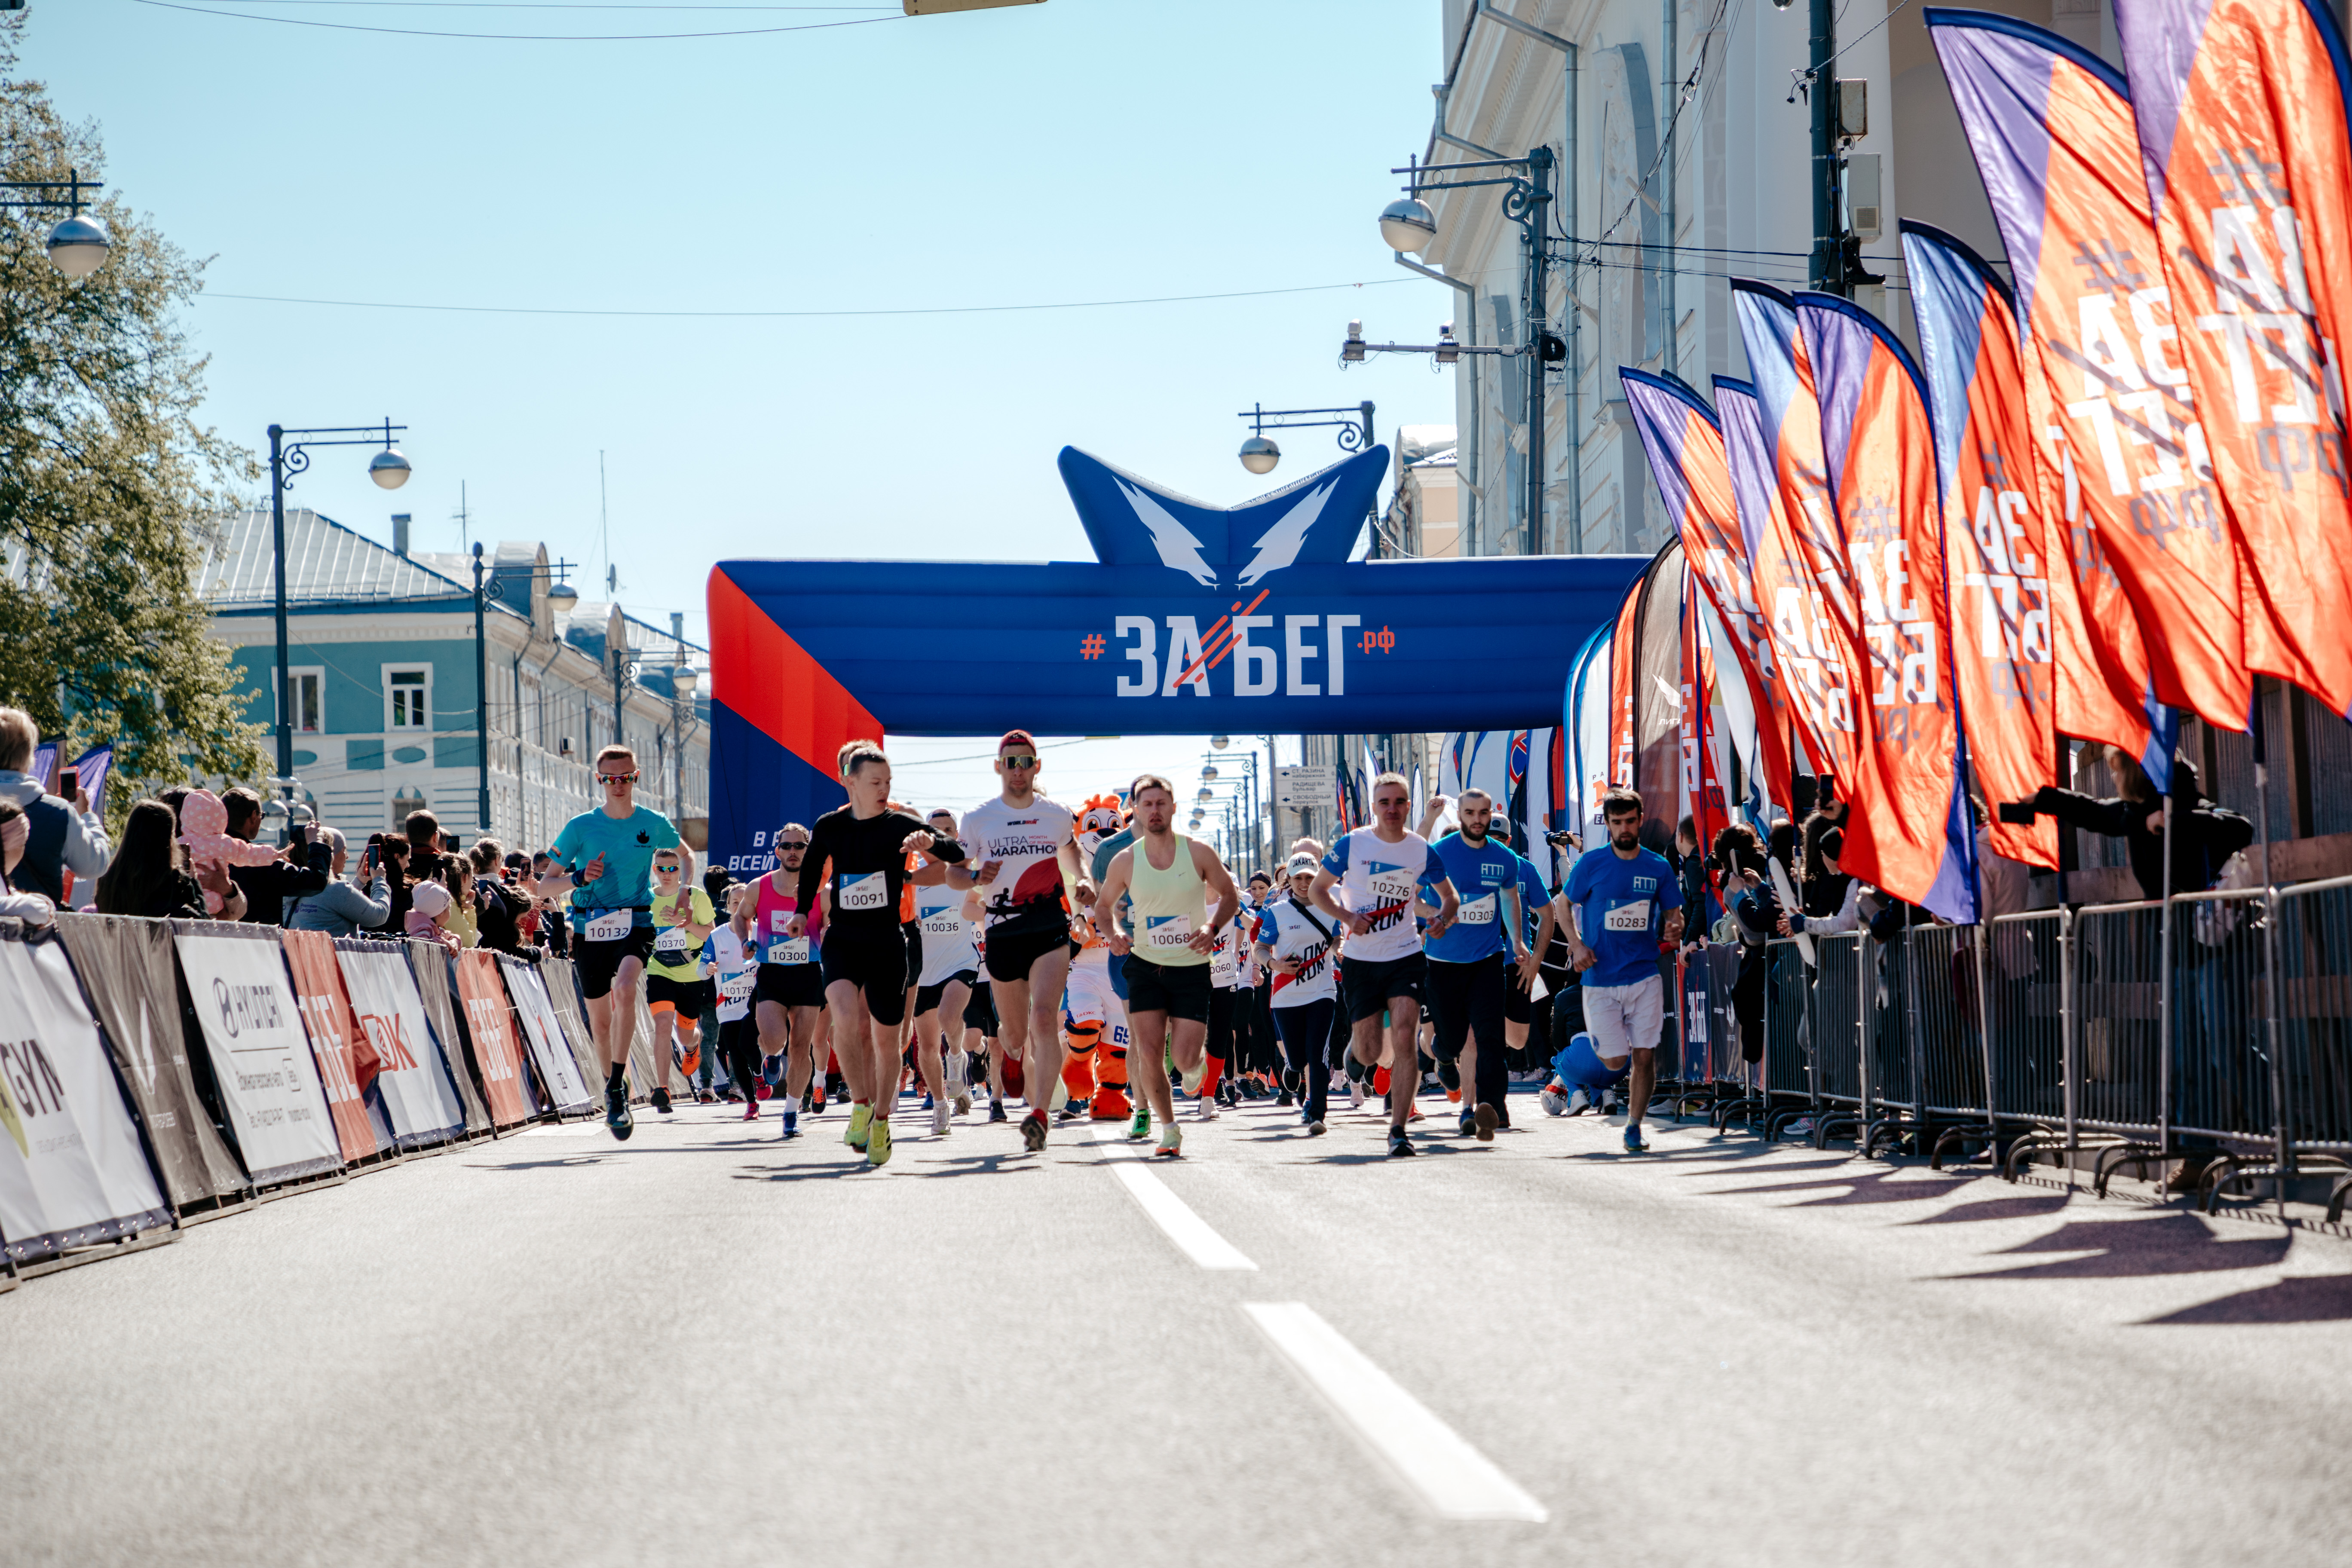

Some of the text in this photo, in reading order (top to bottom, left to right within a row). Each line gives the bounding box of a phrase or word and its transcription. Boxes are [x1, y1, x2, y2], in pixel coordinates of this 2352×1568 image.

[753, 831, 766, 847] В
[988, 836, 1029, 849] ULTRA
[728, 851, 775, 871] ВСЕЙ
[1292, 857, 1314, 868] JAKARTA
[1372, 881, 1410, 897] 10276
[844, 892, 883, 906] 10091
[1462, 910, 1494, 921] 10303
[925, 922, 959, 932] 10036
[1610, 917, 1646, 928] 10283
[590, 927, 629, 937] 10132
[657, 939, 685, 948] 10370
[1152, 933, 1190, 945] 10068
[772, 951, 807, 961] 10300
[1303, 940, 1326, 963] ON
[1210, 962, 1231, 974] 0060
[725, 986, 753, 995] 10178
[1421, 1004, 1429, 1017] 2
